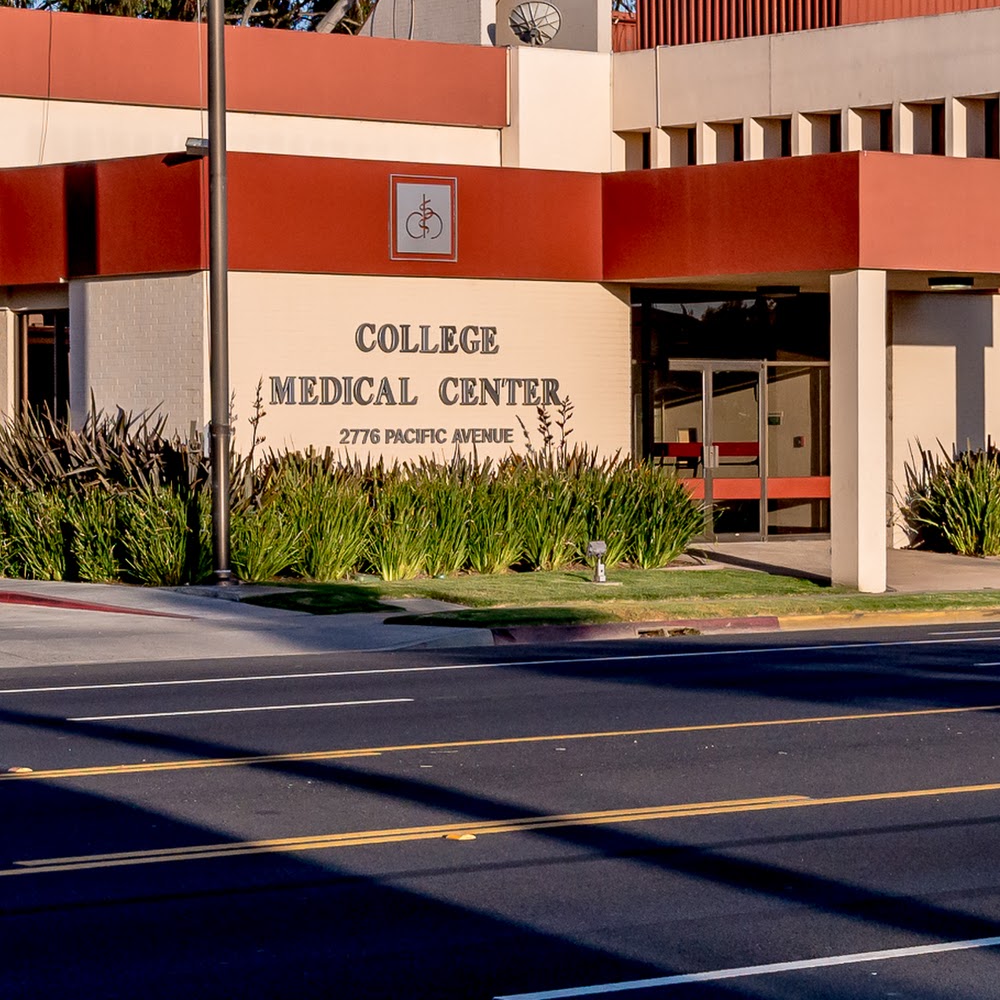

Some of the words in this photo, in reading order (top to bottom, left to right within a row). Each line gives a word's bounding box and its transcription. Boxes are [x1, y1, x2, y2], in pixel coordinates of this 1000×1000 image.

[355, 323, 500, 354] COLLEGE
[269, 375, 418, 406] MEDICAL
[438, 377, 562, 406] CENTER
[339, 428, 381, 445] 2776
[385, 428, 447, 444] PACIFIC
[451, 428, 514, 444] AVENUE
